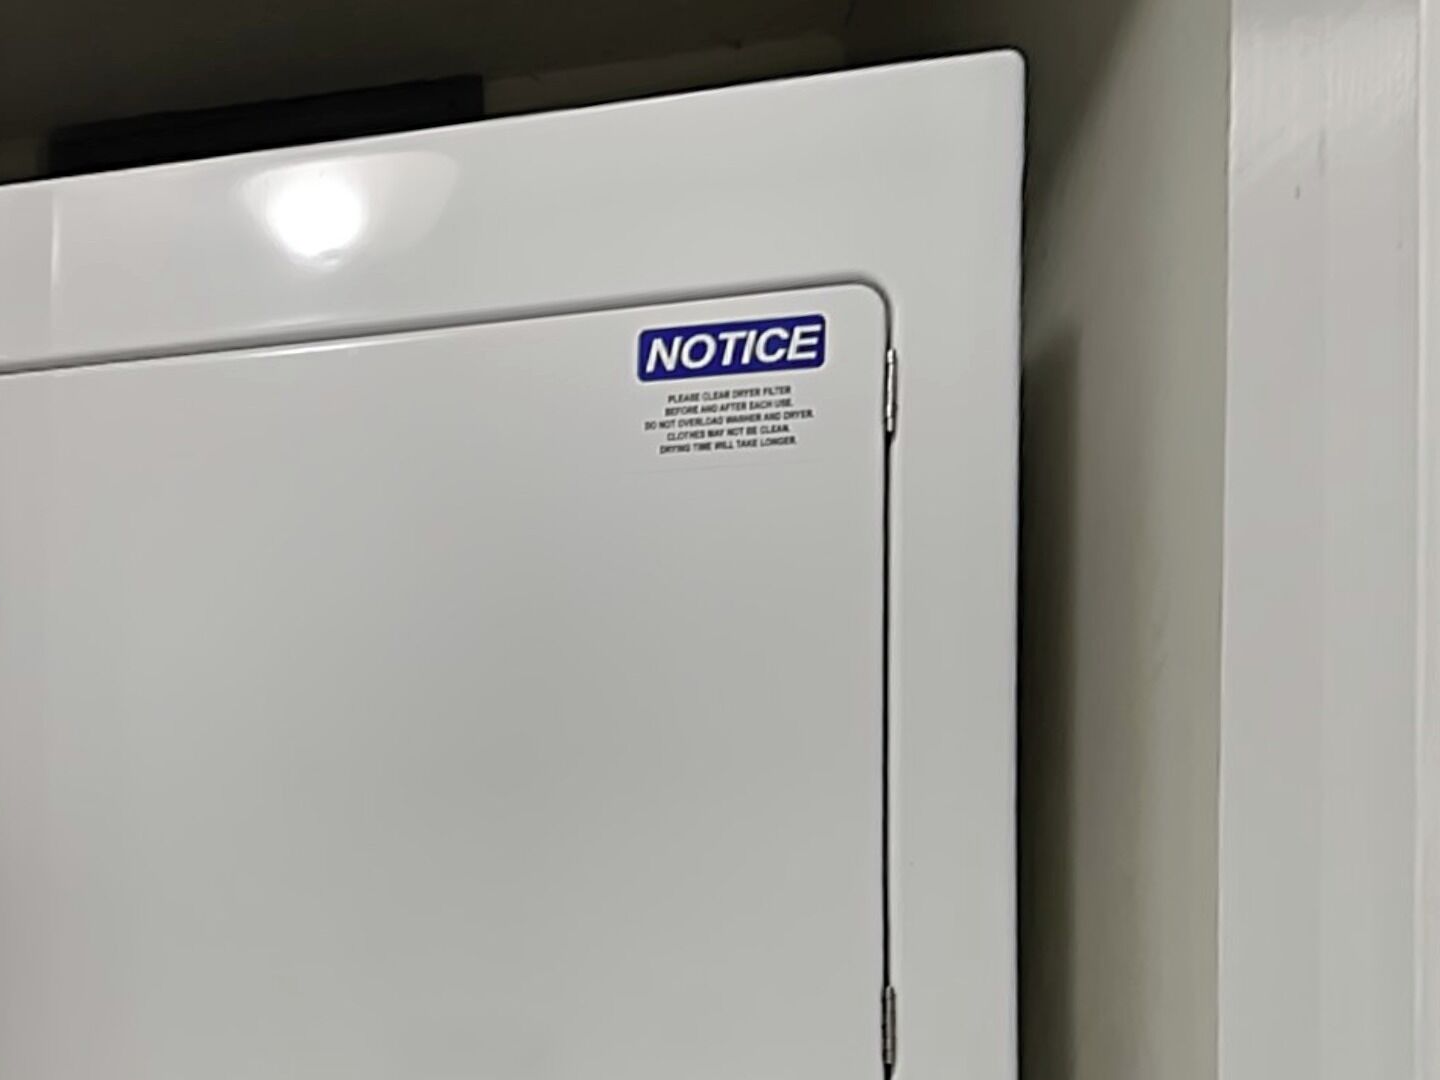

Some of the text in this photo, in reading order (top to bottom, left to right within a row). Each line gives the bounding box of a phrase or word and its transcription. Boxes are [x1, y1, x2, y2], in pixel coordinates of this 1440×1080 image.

[645, 323, 822, 374] NOTICE
[667, 385, 791, 404] PLEASE CLEAR DRYER FILTER
[665, 405, 698, 416] BEFORE
[701, 403, 717, 413] AND
[720, 401, 746, 411] AFTER
[749, 400, 772, 410] EACH
[645, 420, 657, 431] DO
[659, 419, 675, 429] NOT
[678, 415, 724, 428] OVERLOAD
[726, 413, 761, 424] WASHER
[763, 411, 780, 421] AND
[667, 430, 705, 441] CLOTHES
[707, 428, 724, 438] MAY
[727, 426, 743, 436] NOT
[746, 425, 757, 435] BE
[660, 443, 690, 455] DRYING
[692, 441, 711, 451] TIME
[714, 439, 733, 450] WILL
[736, 438, 757, 448] TAKE
